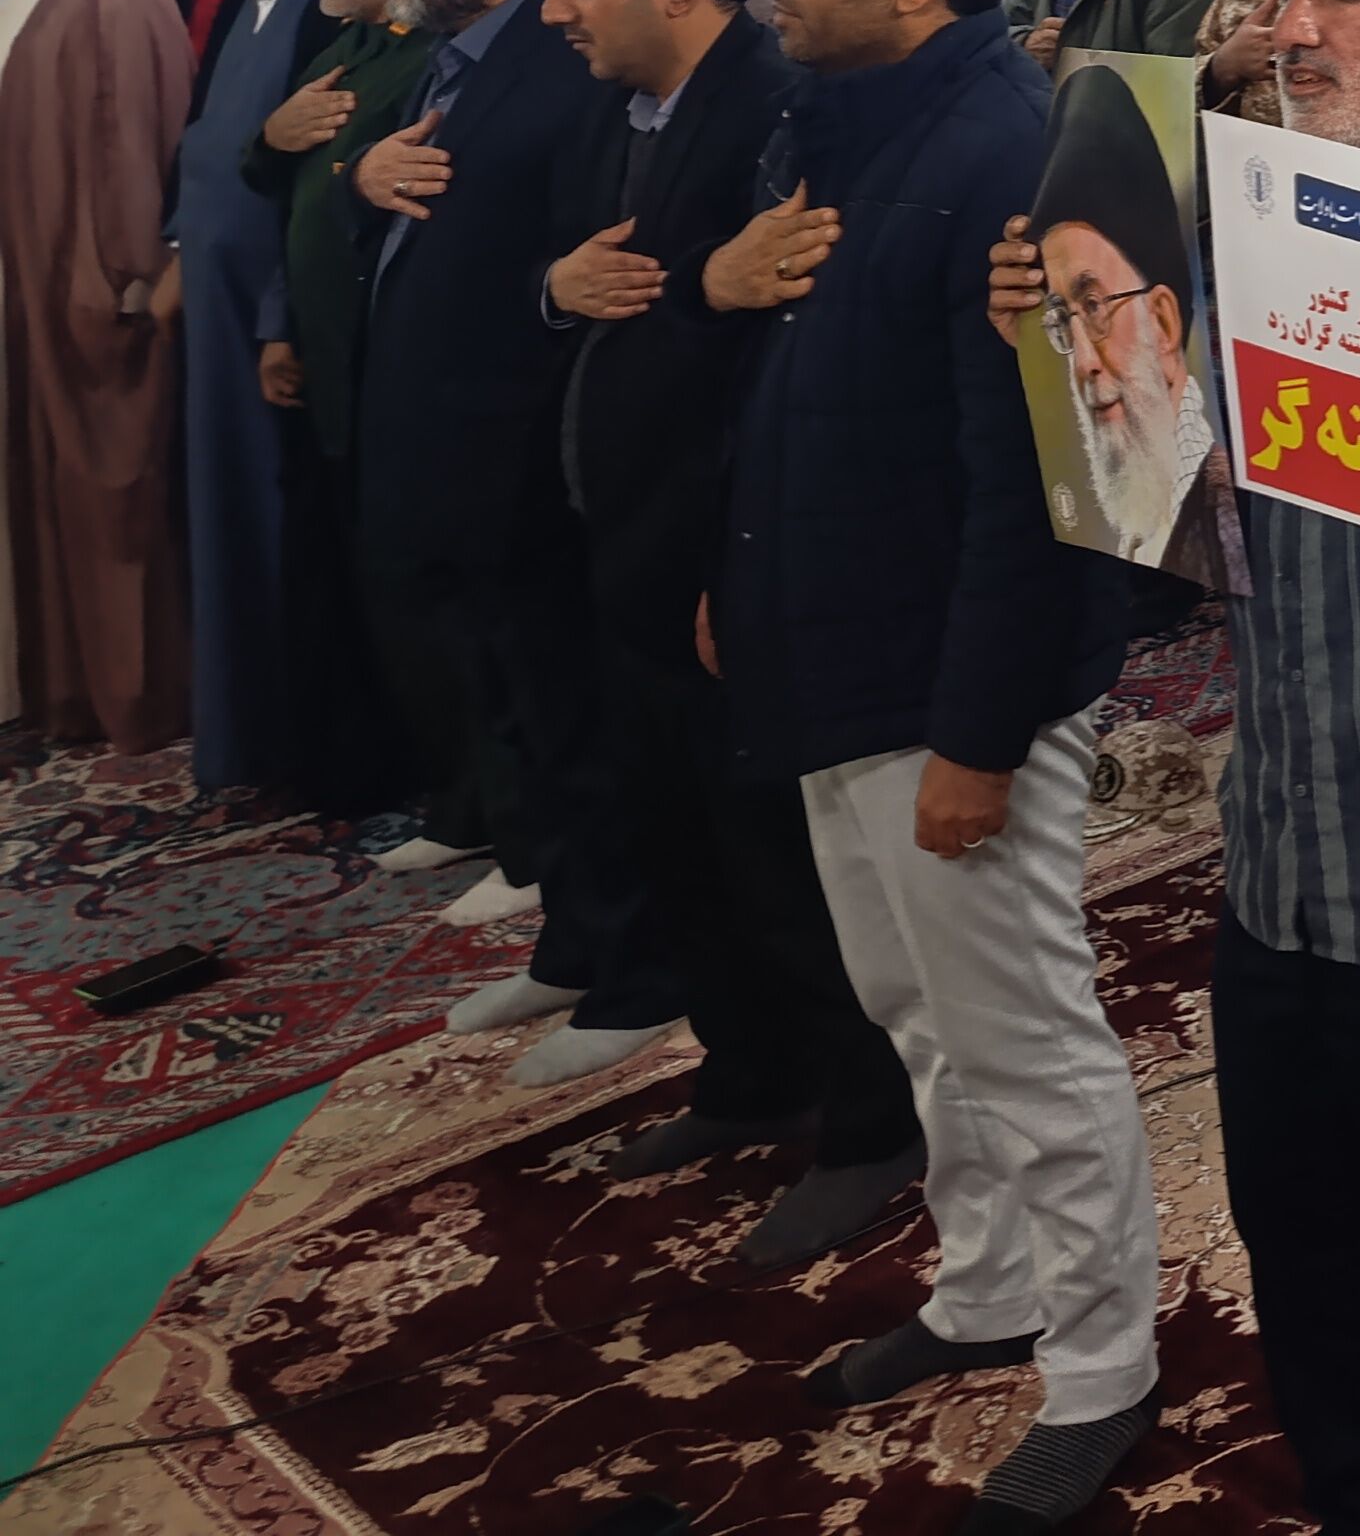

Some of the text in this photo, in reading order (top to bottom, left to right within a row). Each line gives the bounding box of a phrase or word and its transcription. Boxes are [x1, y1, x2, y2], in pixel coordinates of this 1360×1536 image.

[1307, 286, 1350, 314] کشور
[1267, 310, 1288, 340] زد
[1293, 318, 1332, 351] گران
[1249, 377, 1310, 471] گر
